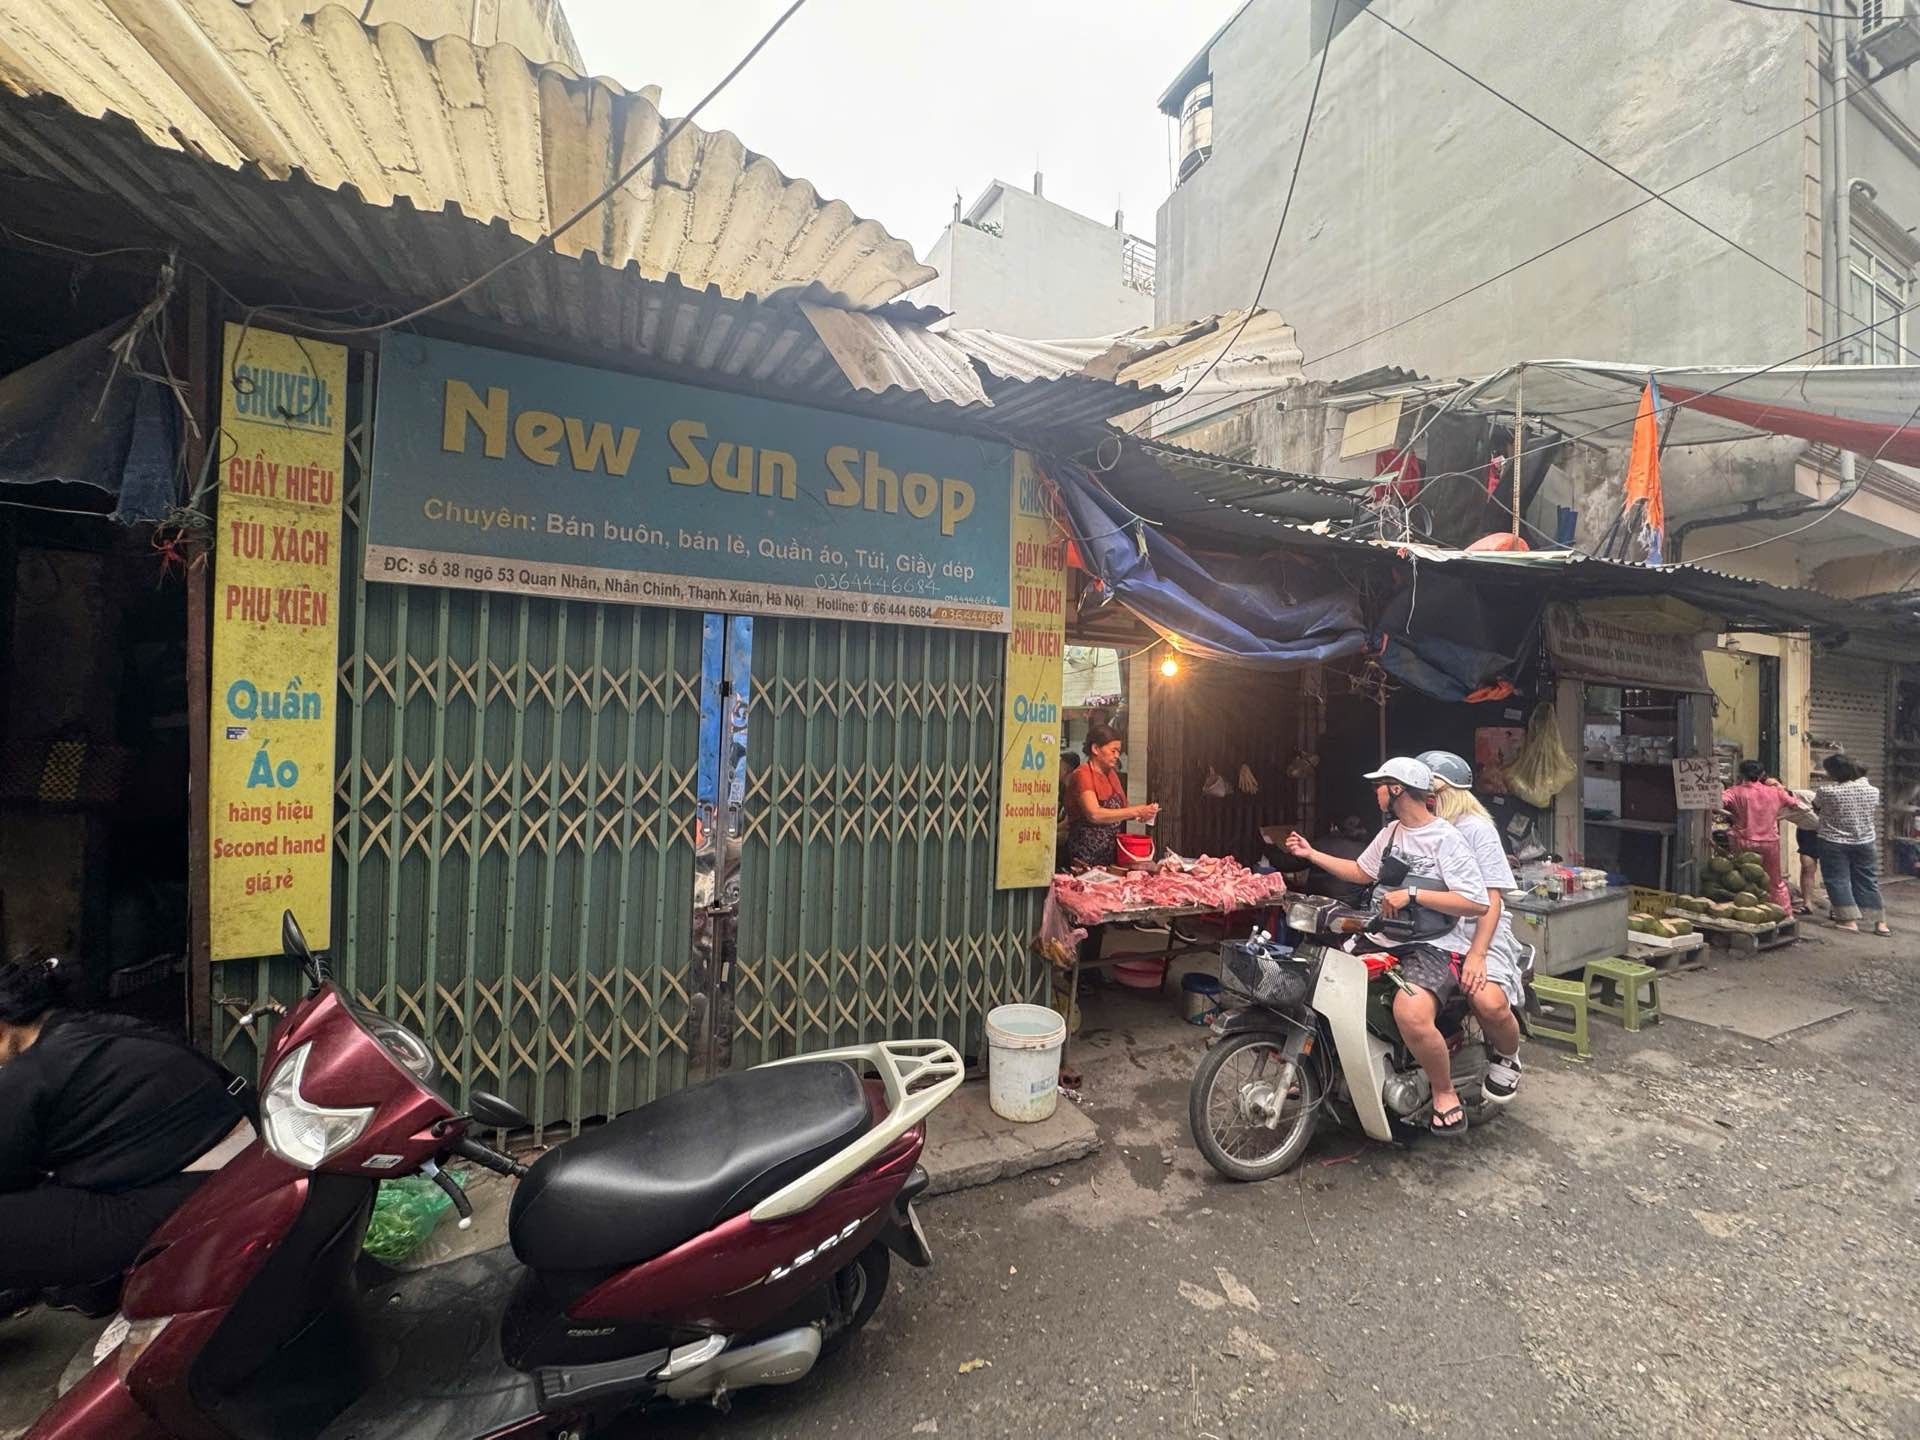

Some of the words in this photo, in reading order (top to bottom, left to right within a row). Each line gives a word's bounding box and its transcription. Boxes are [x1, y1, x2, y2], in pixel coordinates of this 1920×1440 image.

[442, 378, 640, 477] New
[667, 419, 798, 501] Sun
[825, 446, 976, 537] Shop
[231, 515, 264, 559] TÚI
[272, 520, 329, 565] XÁCH
[424, 498, 537, 532] Chuyên:
[546, 512, 595, 538] Bán
[604, 520, 670, 548] buôn,
[678, 529, 719, 551] bán
[758, 537, 812, 561] Quần
[820, 548, 848, 568] áo,
[855, 549, 889, 571] Túi,
[895, 553, 936, 580] Giầy
[942, 559, 975, 583] dép
[384, 556, 413, 574] ĐC:
[418, 558, 437, 576] số
[442, 562, 460, 578] 38
[465, 566, 493, 583] ngõ
[497, 567, 515, 583] 53
[519, 570, 556, 588] Quan
[561, 574, 601, 592] Nhân,
[605, 578, 638, 594] Nhân
[688, 585, 726, 601] Thanh
[730, 588, 763, 607] Xuân,
[785, 593, 804, 610] Nội
[817, 597, 858, 613] Hotline:
[889, 603, 906, 616] 444
[909, 605, 932, 618] 6684
[226, 585, 271, 631] PHỤ
[278, 584, 328, 633] KIỆN
[226, 675, 322, 720] Quần
[1013, 692, 1057, 723] Quần
[246, 739, 299, 789] Áo
[1021, 736, 1045, 770] Áo
[1012, 778, 1033, 795] hàng
[1034, 778, 1051, 795] hiệu
[228, 801, 272, 824] hàng
[276, 800, 314, 824] hiệu
[1005, 802, 1035, 818] Second
[1036, 802, 1057, 817] hand
[213, 836, 278, 859] Second
[282, 834, 326, 854] hand
[1018, 826, 1031, 844] giá
[245, 870, 272, 896] giá
[276, 867, 294, 889] rẻ
